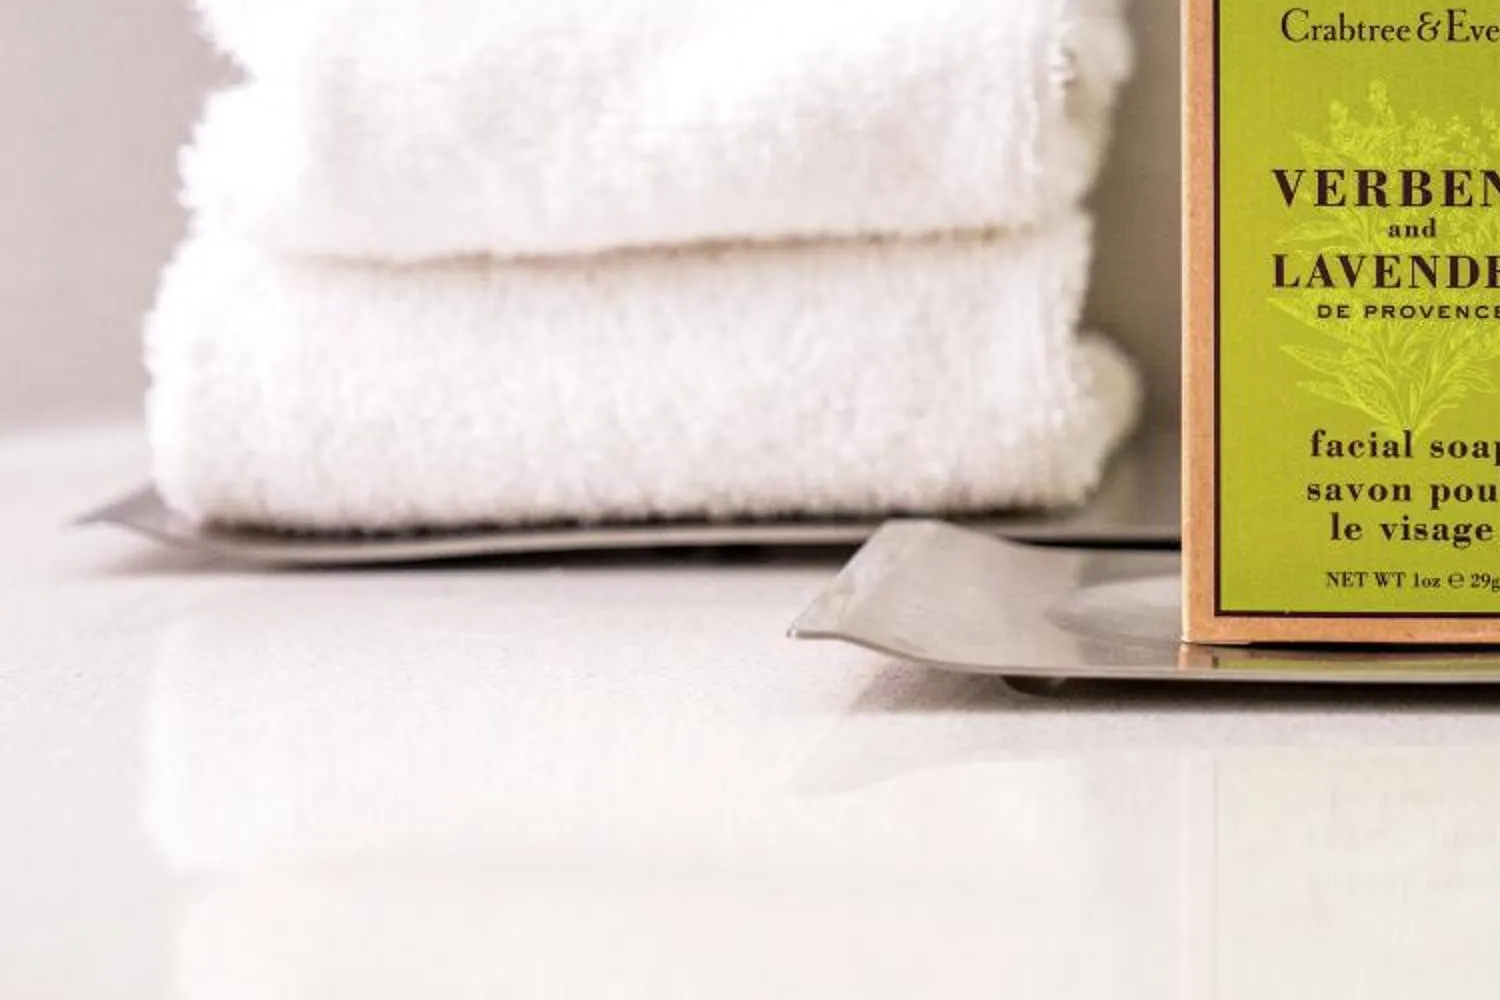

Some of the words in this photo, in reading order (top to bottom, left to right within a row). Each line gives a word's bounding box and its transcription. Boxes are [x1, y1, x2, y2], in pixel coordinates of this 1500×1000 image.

[1280, 7, 1411, 43] Crabtree
[1388, 217, 1436, 238] and
[1316, 304, 1350, 319] DE
[1310, 428, 1413, 459] facial
[1307, 483, 1412, 502] savon
[1330, 511, 1363, 541] le
[1379, 513, 1494, 550] visage
[1325, 571, 1369, 588] NET
[1372, 571, 1406, 588] WT
